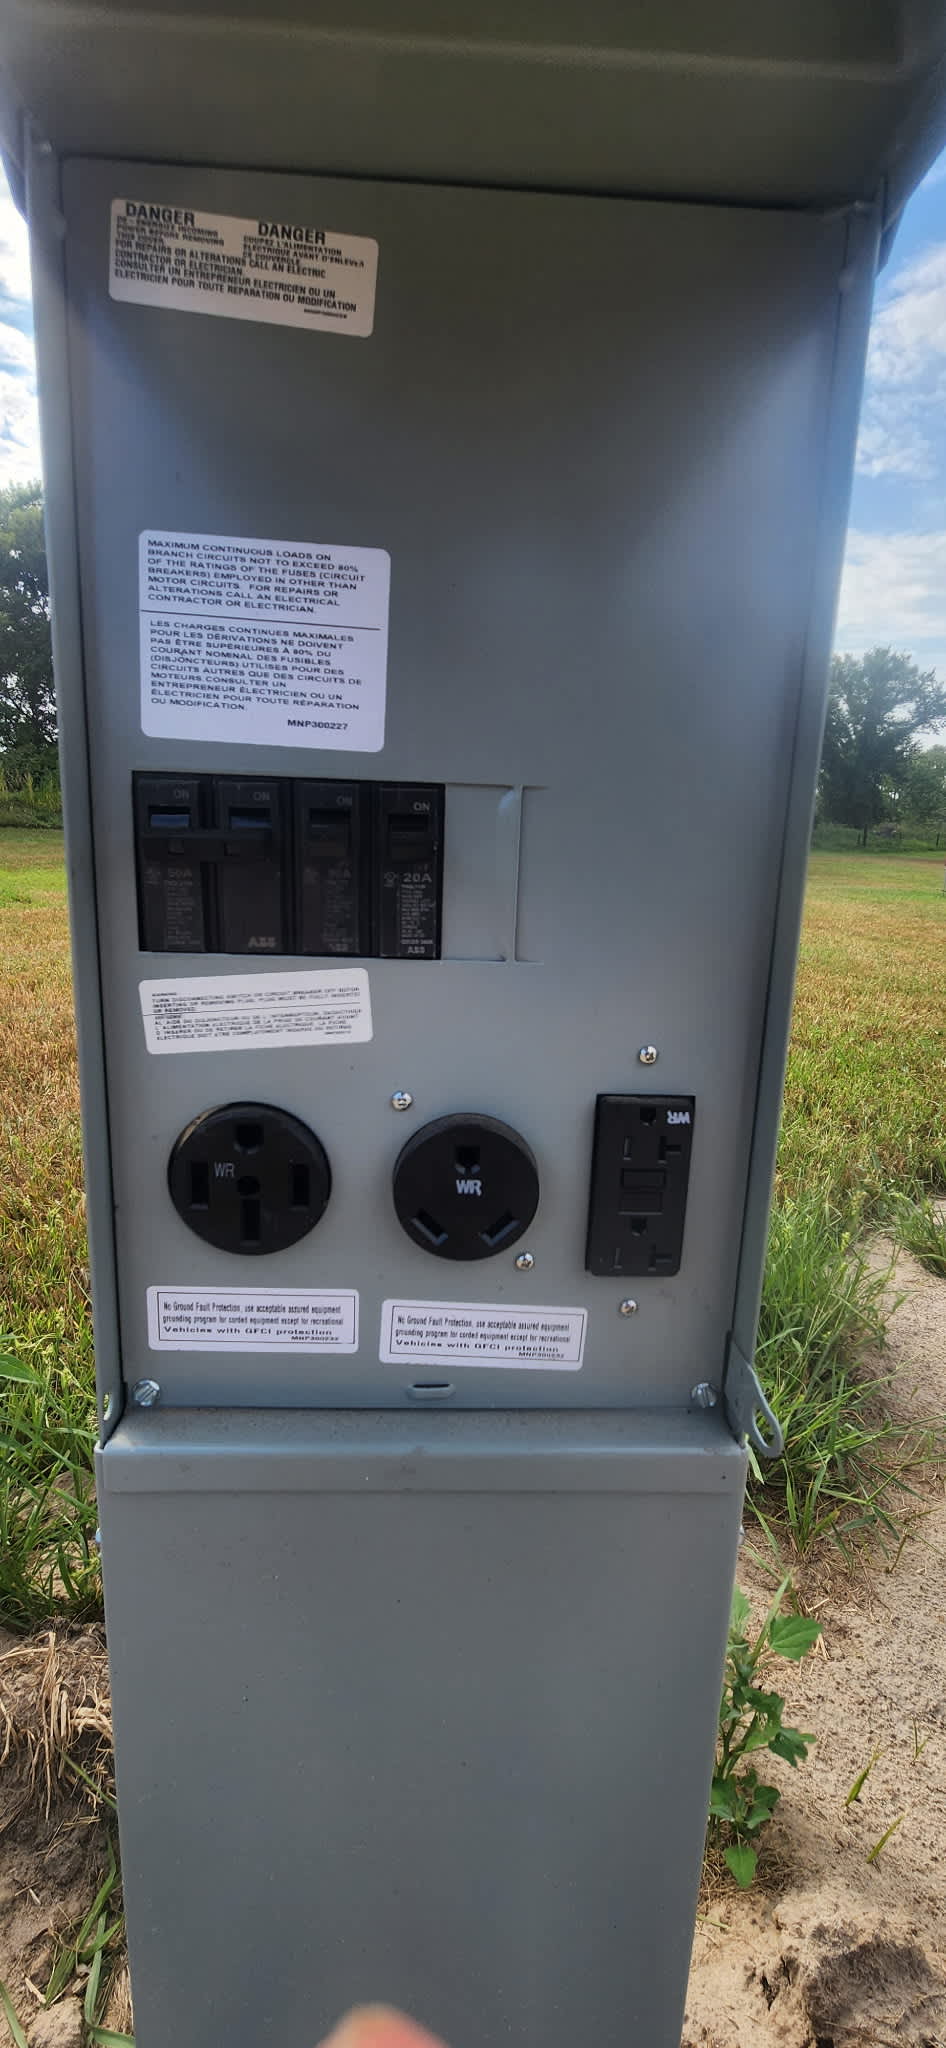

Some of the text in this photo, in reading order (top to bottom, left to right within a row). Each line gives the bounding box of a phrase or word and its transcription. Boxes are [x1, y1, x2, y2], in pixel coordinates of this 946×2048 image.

[126, 202, 195, 226] DANGER
[258, 223, 325, 245] DANGER
[115, 250, 171, 263] CONTRACTOR
[174, 259, 186, 267] OR
[116, 239, 132, 249] FOR
[136, 241, 171, 255] REPAIRS
[175, 248, 186, 257] OR
[189, 248, 247, 266] ALTERATIONS
[249, 260, 268, 270] CALL
[272, 263, 284, 273] AN
[287, 264, 326, 279] ELECTRIC
[115, 259, 165, 273] CONSULTER
[169, 267, 180, 276] UN
[184, 268, 251, 287] ENTREPRENEUR
[309, 287, 320, 297] OU
[323, 289, 335, 299] UN
[114, 269, 356, 312] ELECTRICIEN POUR TOUTE REPARATION OU MODIFICATION
[148, 540, 199, 550] MAXIMUM
[203, 544, 272, 556] CONTINUOUS
[276, 550, 312, 559] LOADS
[148, 549, 193, 559] BRANCH
[196, 553, 246, 562] CIRCUITS
[293, 561, 334, 570] EXCEED
[148, 567, 210, 578] BREAKERS)
[214, 573, 272, 583] EMPLOYED
[289, 578, 325, 587] OTHER
[329, 582, 357, 590] THAN
[190, 561, 237, 571] RATINGS
[259, 567, 279, 575] THE
[282, 569, 316, 577] FUSES
[320, 572, 365, 581] (CIRCUIT
[148, 576, 186, 584] MOTOR
[274, 586, 319, 596] REPAIRS
[148, 585, 222, 596] ALTERATIONS
[226, 591, 253, 599] CALL
[275, 595, 340, 606] ELECTRICAL
[148, 594, 222, 605] CONTRACTOR
[150, 629, 180, 637] POUR
[298, 641, 343, 649] DOIVENT
[174, 622, 225, 631] CHARGES
[229, 626, 289, 637] CONTINUES
[293, 632, 354, 642] MAXIMALES
[175, 638, 202, 647] ÊTRE
[150, 646, 202, 656] COURANT
[206, 651, 253, 660] NOMINAL
[281, 656, 331, 666] FUSIBLES
[151, 655, 239, 668] (DISJONCTEURS)
[292, 665, 320, 673] POUR
[150, 664, 199, 673] CIRCUITS
[203, 667, 245, 676] AUTRES
[297, 674, 345, 684] CIRCUITS
[151, 672, 201, 681] MOTEURS
[205, 676, 268, 686] CONSULTER
[151, 681, 235, 692] ENTREPRENEUR
[223, 694, 252, 702] POUR
[256, 697, 289, 705] TOUTE
[287, 719, 348, 730] MNP300227
[174, 789, 189, 800] ON
[254, 791, 270, 801] ON
[414, 802, 430, 812] ON
[403, 873, 432, 883] 20A
[666, 1110, 690, 1125] WR
[214, 1163, 235, 1177] WR
[456, 1180, 482, 1195] WR
[164, 1302, 171, 1311] No
[173, 1301, 193, 1311] Ground
[196, 1302, 210, 1311] Fault
[256, 1304, 286, 1313] acceptable
[288, 1305, 309, 1313] assured
[312, 1306, 341, 1314] equipment
[398, 1316, 404, 1324] No
[407, 1316, 427, 1325] Ground
[429, 1316, 442, 1326] Fault
[488, 1321, 516, 1330] acceptable
[519, 1322, 539, 1330] assured
[541, 1323, 569, 1332] equipment
[396, 1329, 423, 1338] grounding
[426, 1330, 448, 1338] program
[480, 1332, 508, 1341] equipment
[540, 1335, 570, 1343] recreational
